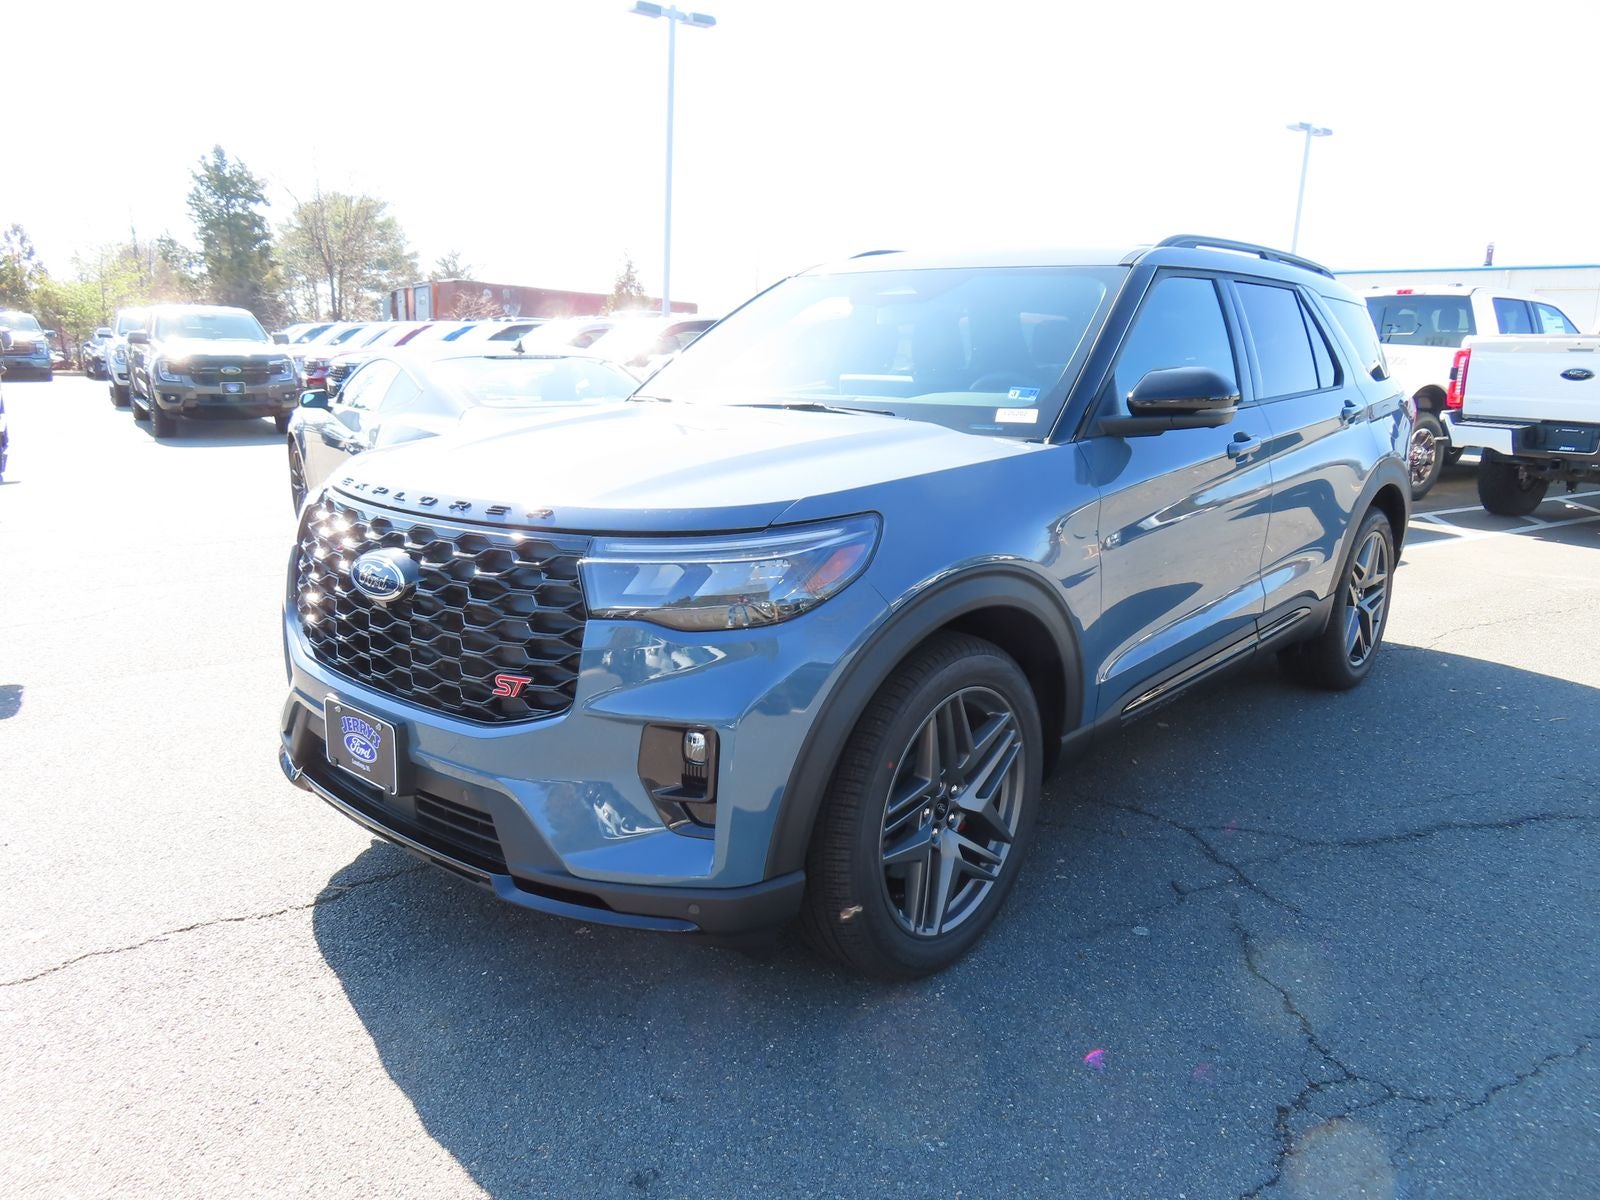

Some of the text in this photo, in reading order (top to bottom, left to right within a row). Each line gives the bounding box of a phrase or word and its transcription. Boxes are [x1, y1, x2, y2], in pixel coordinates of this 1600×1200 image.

[342, 477, 553, 519] EXPLORER
[359, 563, 388, 590] Ford
[492, 674, 531, 697] ST
[341, 716, 381, 748] JERRY'S
[350, 737, 370, 759] Ford
